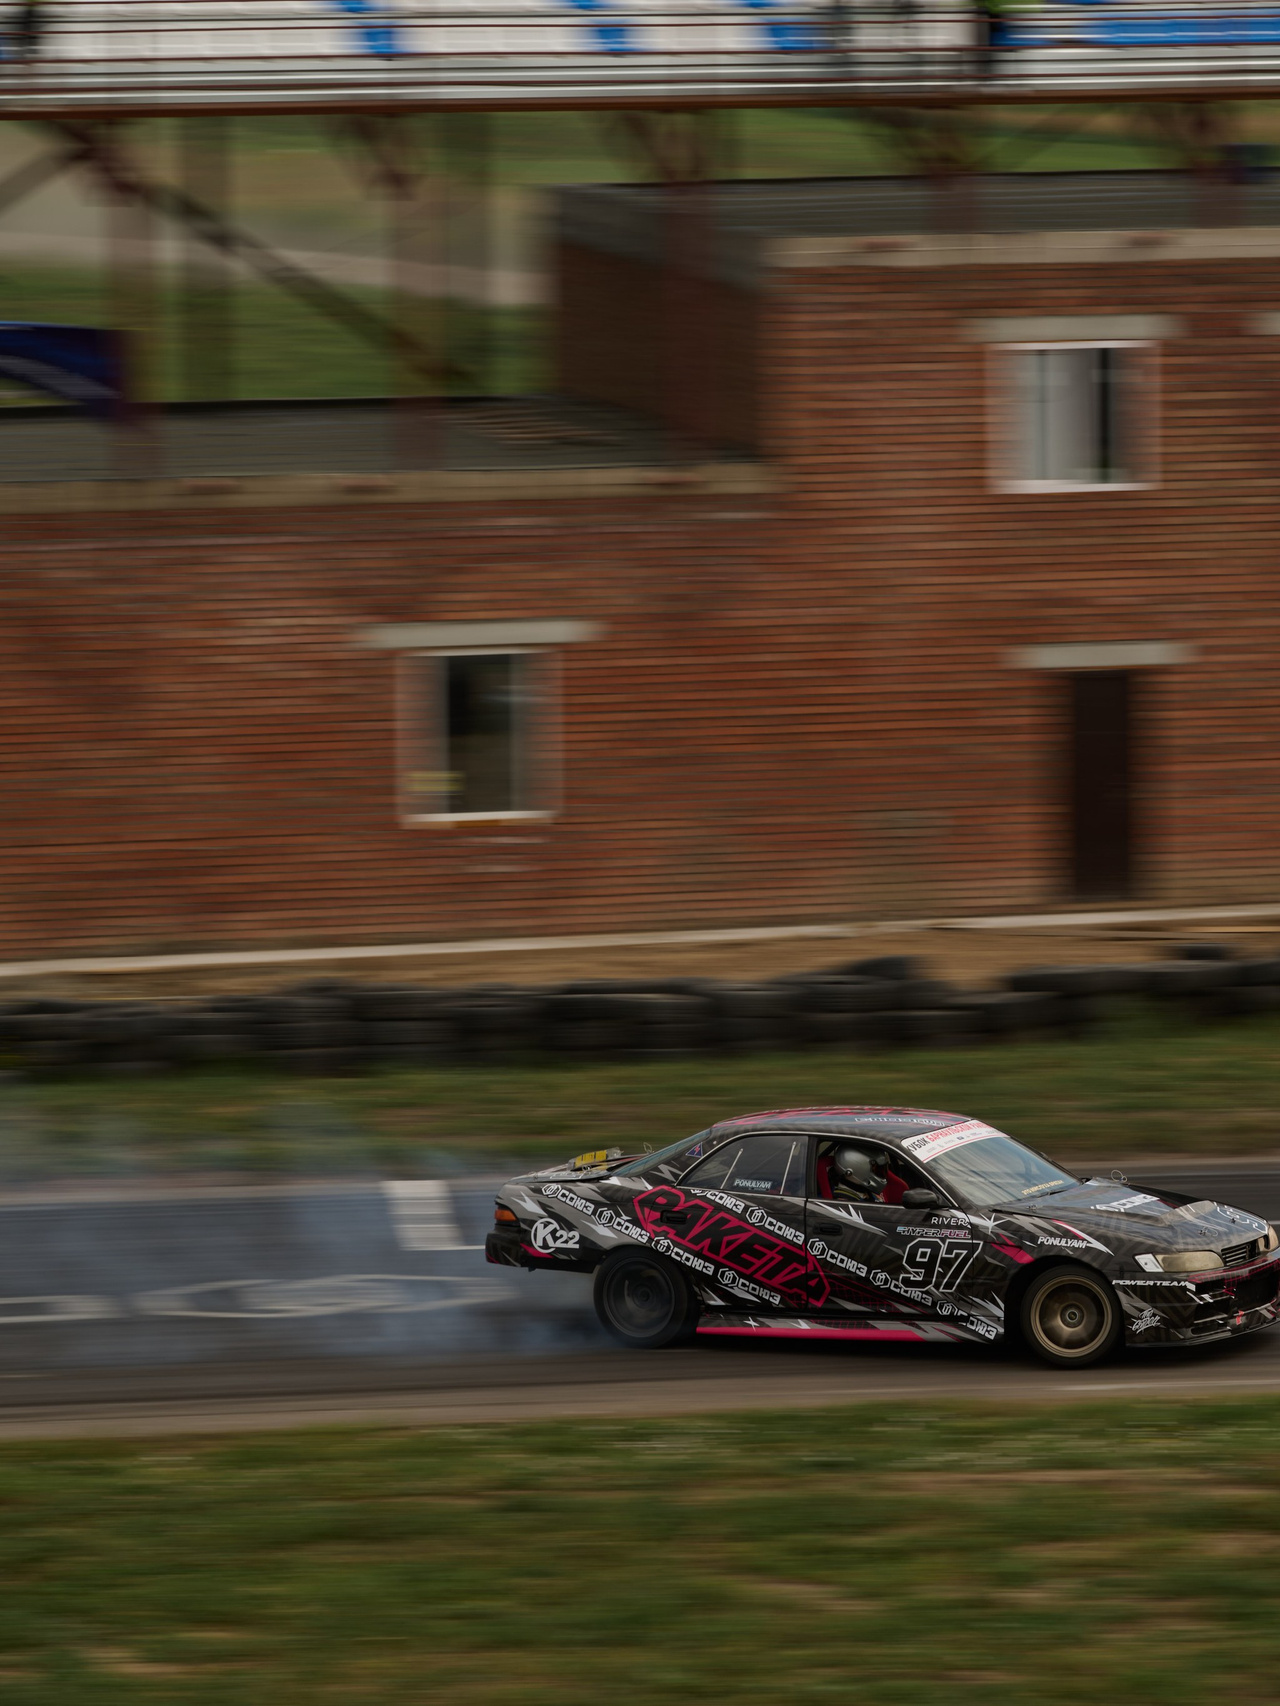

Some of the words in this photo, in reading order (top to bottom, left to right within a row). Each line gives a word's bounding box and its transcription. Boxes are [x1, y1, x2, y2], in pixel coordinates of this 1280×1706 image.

[906, 1136, 931, 1152] КУБОК
[733, 1178, 773, 1189] PONULYAM
[931, 1216, 967, 1227] RIVER
[1037, 1236, 1088, 1249] PONULYAM
[899, 1238, 983, 1293] 97
